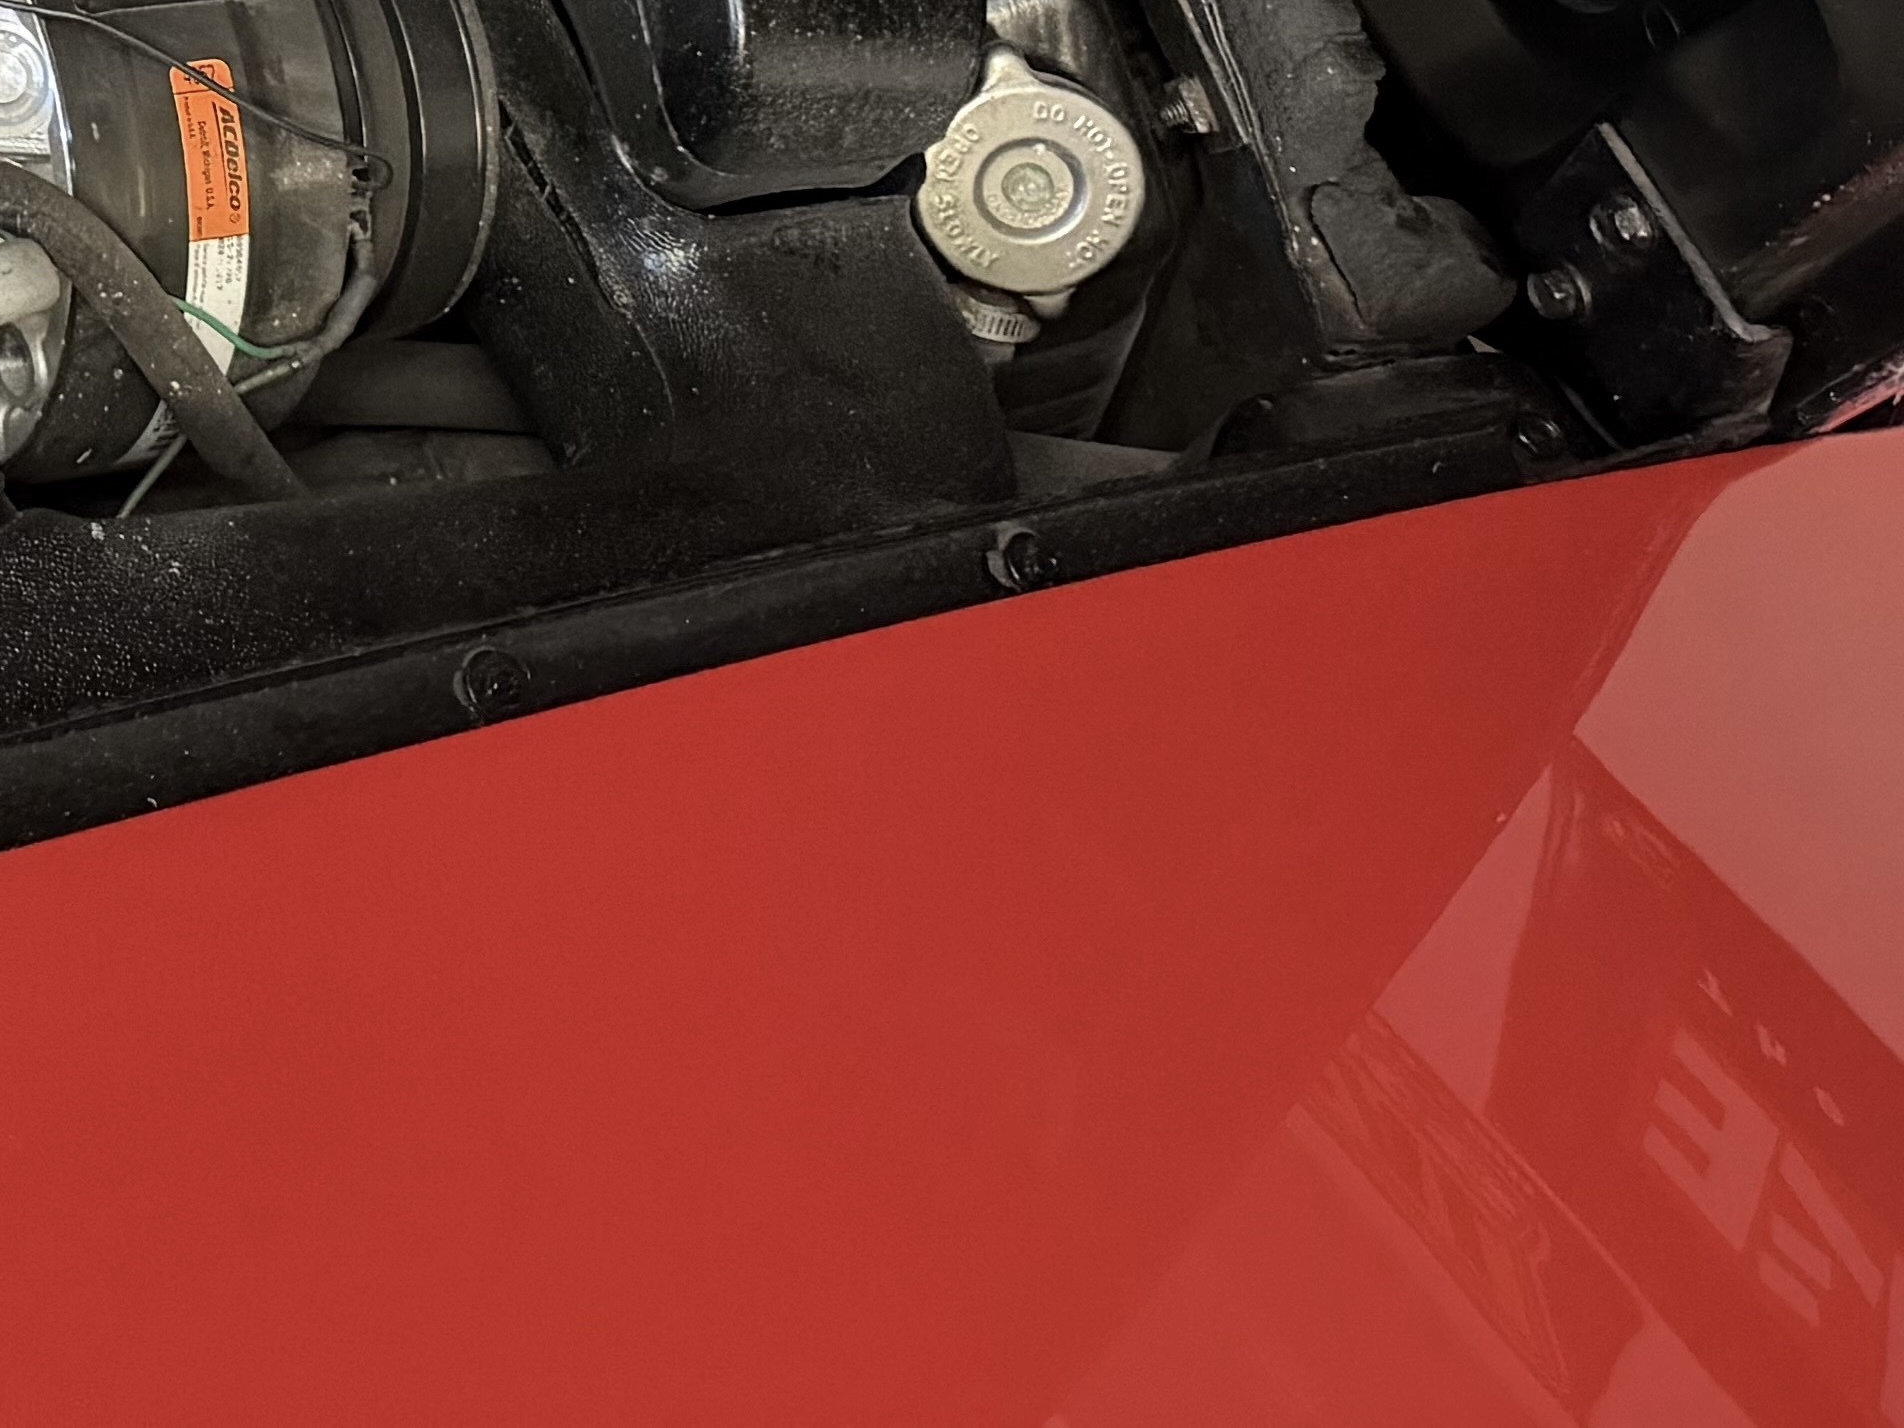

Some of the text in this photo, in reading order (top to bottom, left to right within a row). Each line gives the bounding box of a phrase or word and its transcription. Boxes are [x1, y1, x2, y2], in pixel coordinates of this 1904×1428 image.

[202, 151, 212, 184] Michigan
[1031, 100, 1066, 123] DO
[1103, 162, 1130, 227] OPEN
